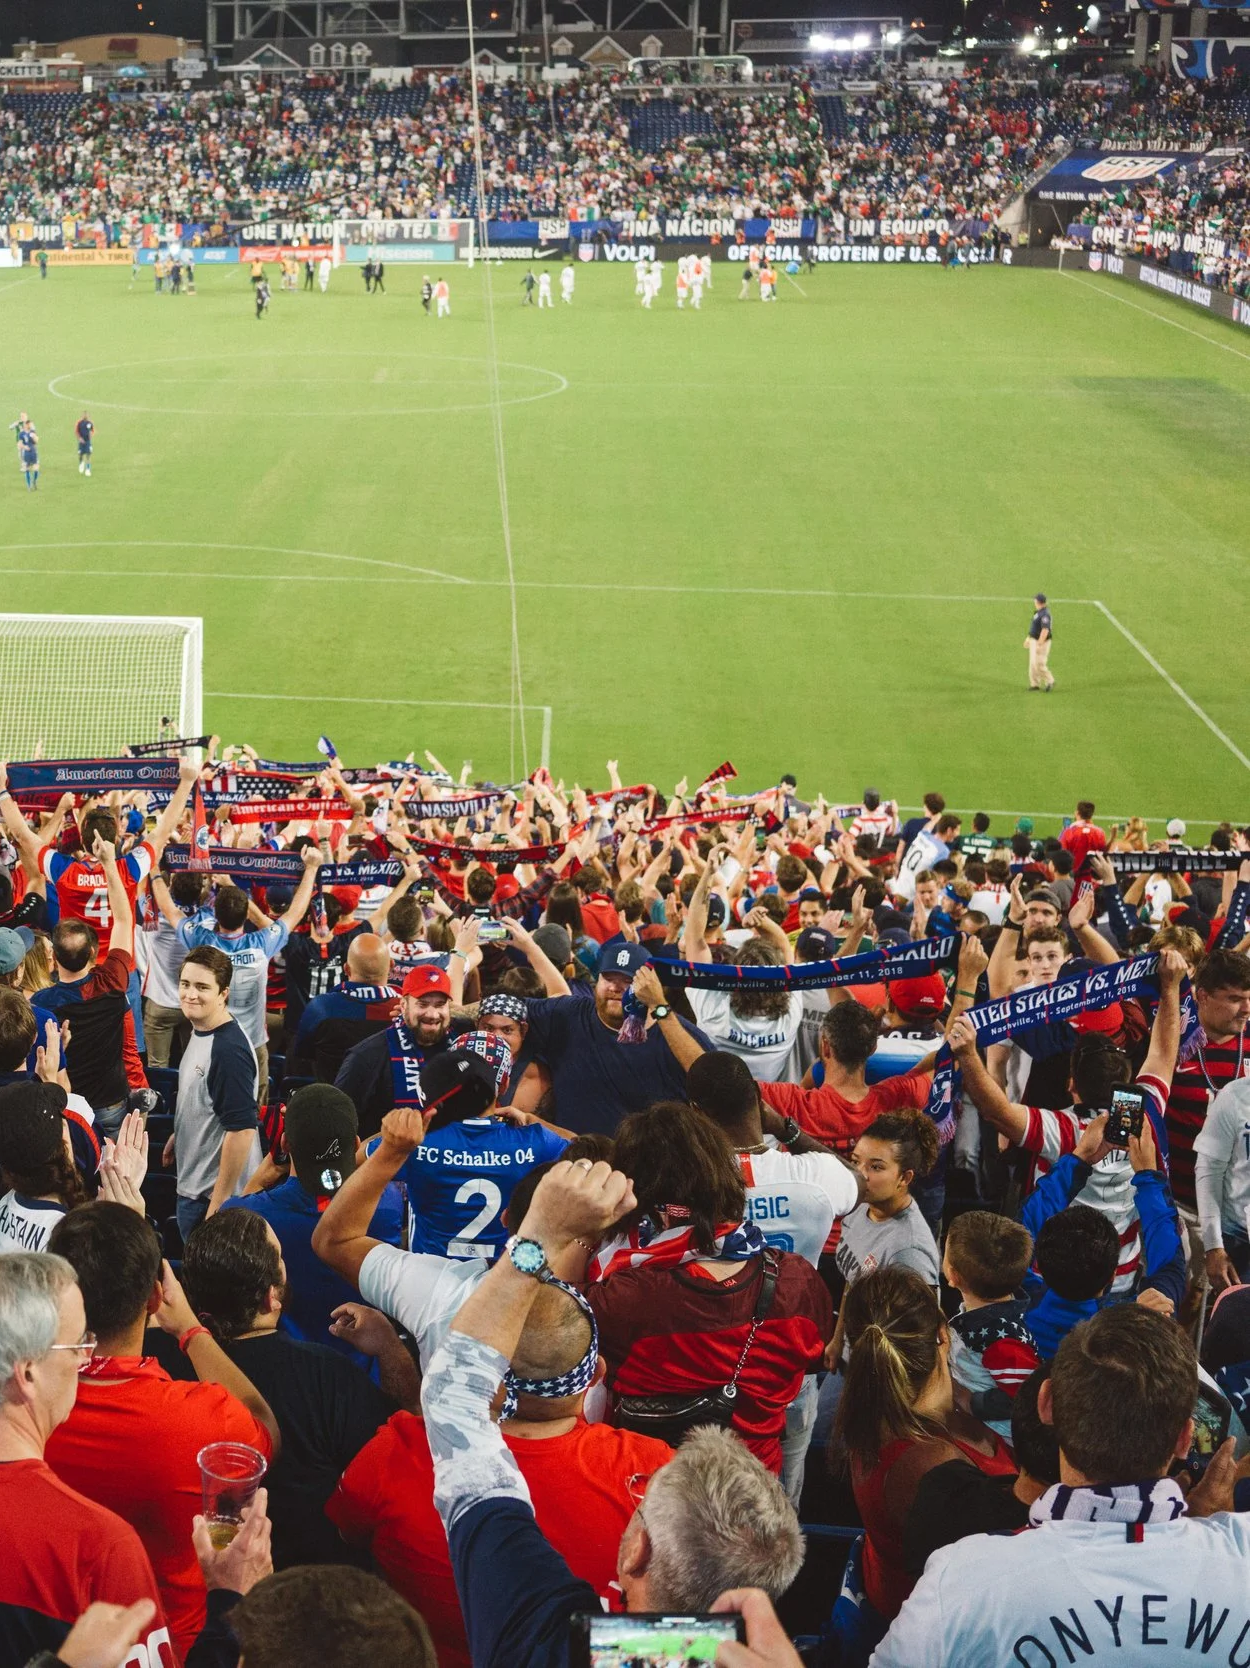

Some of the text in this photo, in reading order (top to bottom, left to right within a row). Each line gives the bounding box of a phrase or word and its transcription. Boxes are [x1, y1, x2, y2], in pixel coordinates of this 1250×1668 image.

[242, 224, 277, 241] ONE
[853, 218, 875, 237] UN
[728, 244, 802, 261] OFCIAL
[883, 245, 905, 262] OF
[56, 765, 181, 782] American Outla
[231, 802, 295, 815] American
[421, 796, 499, 819] NASHVILLE
[77, 873, 108, 888] BRADL
[84, 887, 112, 928] 4
[798, 972, 855, 986] September
[858, 969, 875, 982] 11,
[877, 966, 904, 978] 2018
[966, 952, 1160, 1031] NITED STATES VS. MEXI
[991, 1016, 1034, 1036] Nashville,
[1055, 995, 1101, 1016] September
[1116, 983, 1137, 996] 2018
[729, 1028, 787, 1049] MITCHELL
[416, 1145, 535, 1167] FC Schalke 04
[446, 1178, 502, 1258] 2
[745, 1195, 790, 1221] ISIC
[723, 1278, 738, 1289] USA
